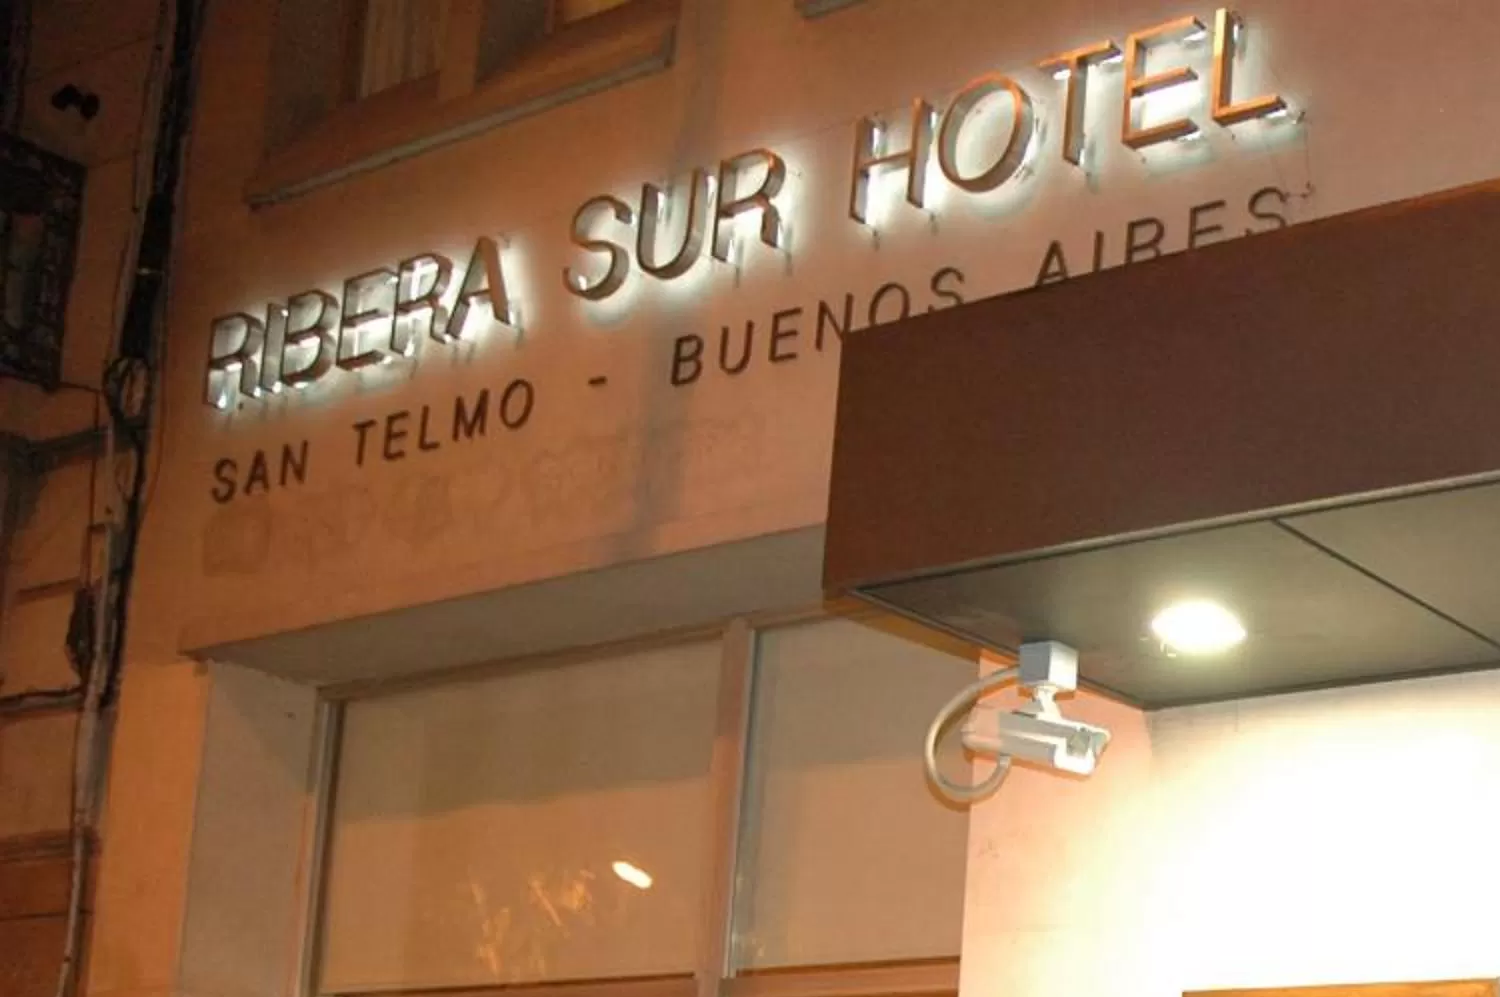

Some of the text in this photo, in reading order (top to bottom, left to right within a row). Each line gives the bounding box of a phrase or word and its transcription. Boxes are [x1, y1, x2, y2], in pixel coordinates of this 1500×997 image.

[206, 7, 1287, 410] RIBERA SUR HOTEL
[211, 440, 309, 505] SAN
[352, 378, 535, 468] TELMO
[670, 265, 966, 388] BUENOS
[1035, 186, 1290, 288] AIRES
